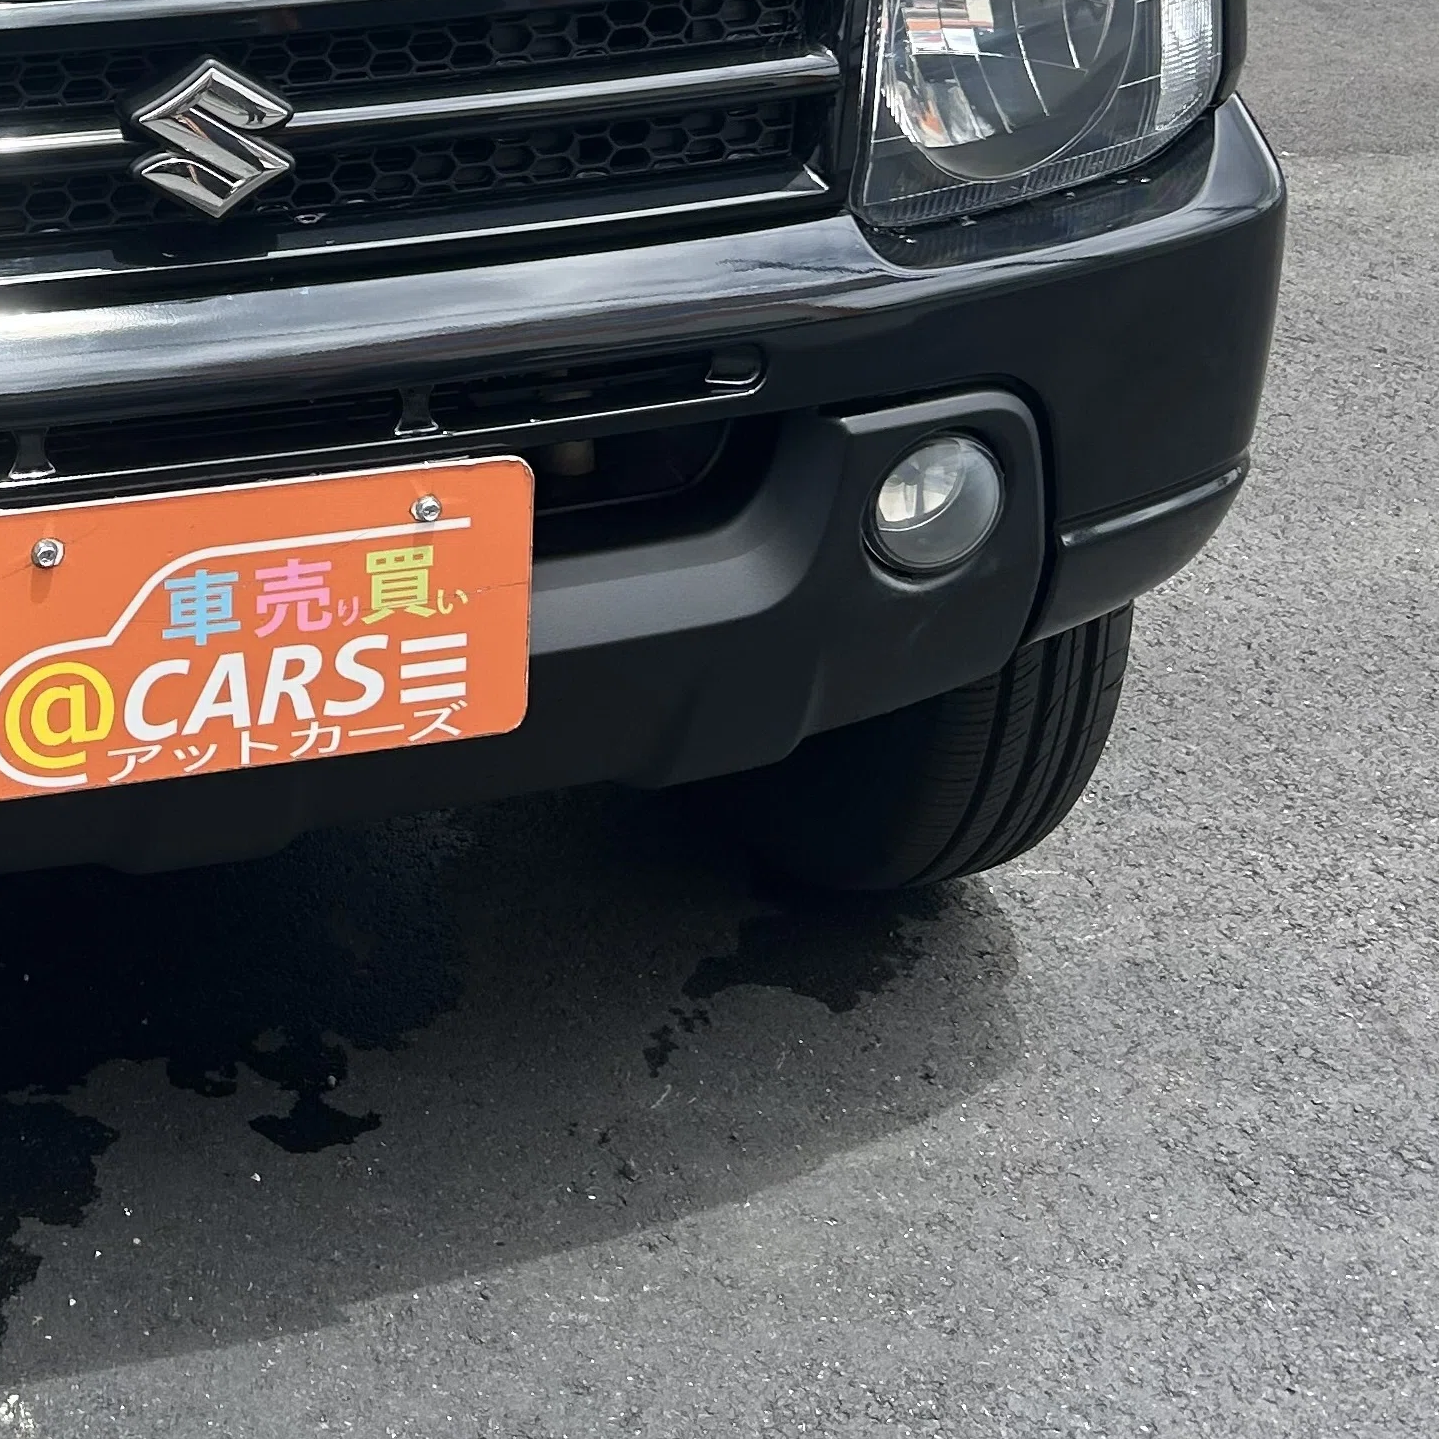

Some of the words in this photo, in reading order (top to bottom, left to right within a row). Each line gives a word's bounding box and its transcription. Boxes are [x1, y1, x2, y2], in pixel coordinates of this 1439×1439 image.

[162, 544, 469, 647] 車売り買い
[107, 699, 469, 784] アットカーズ
